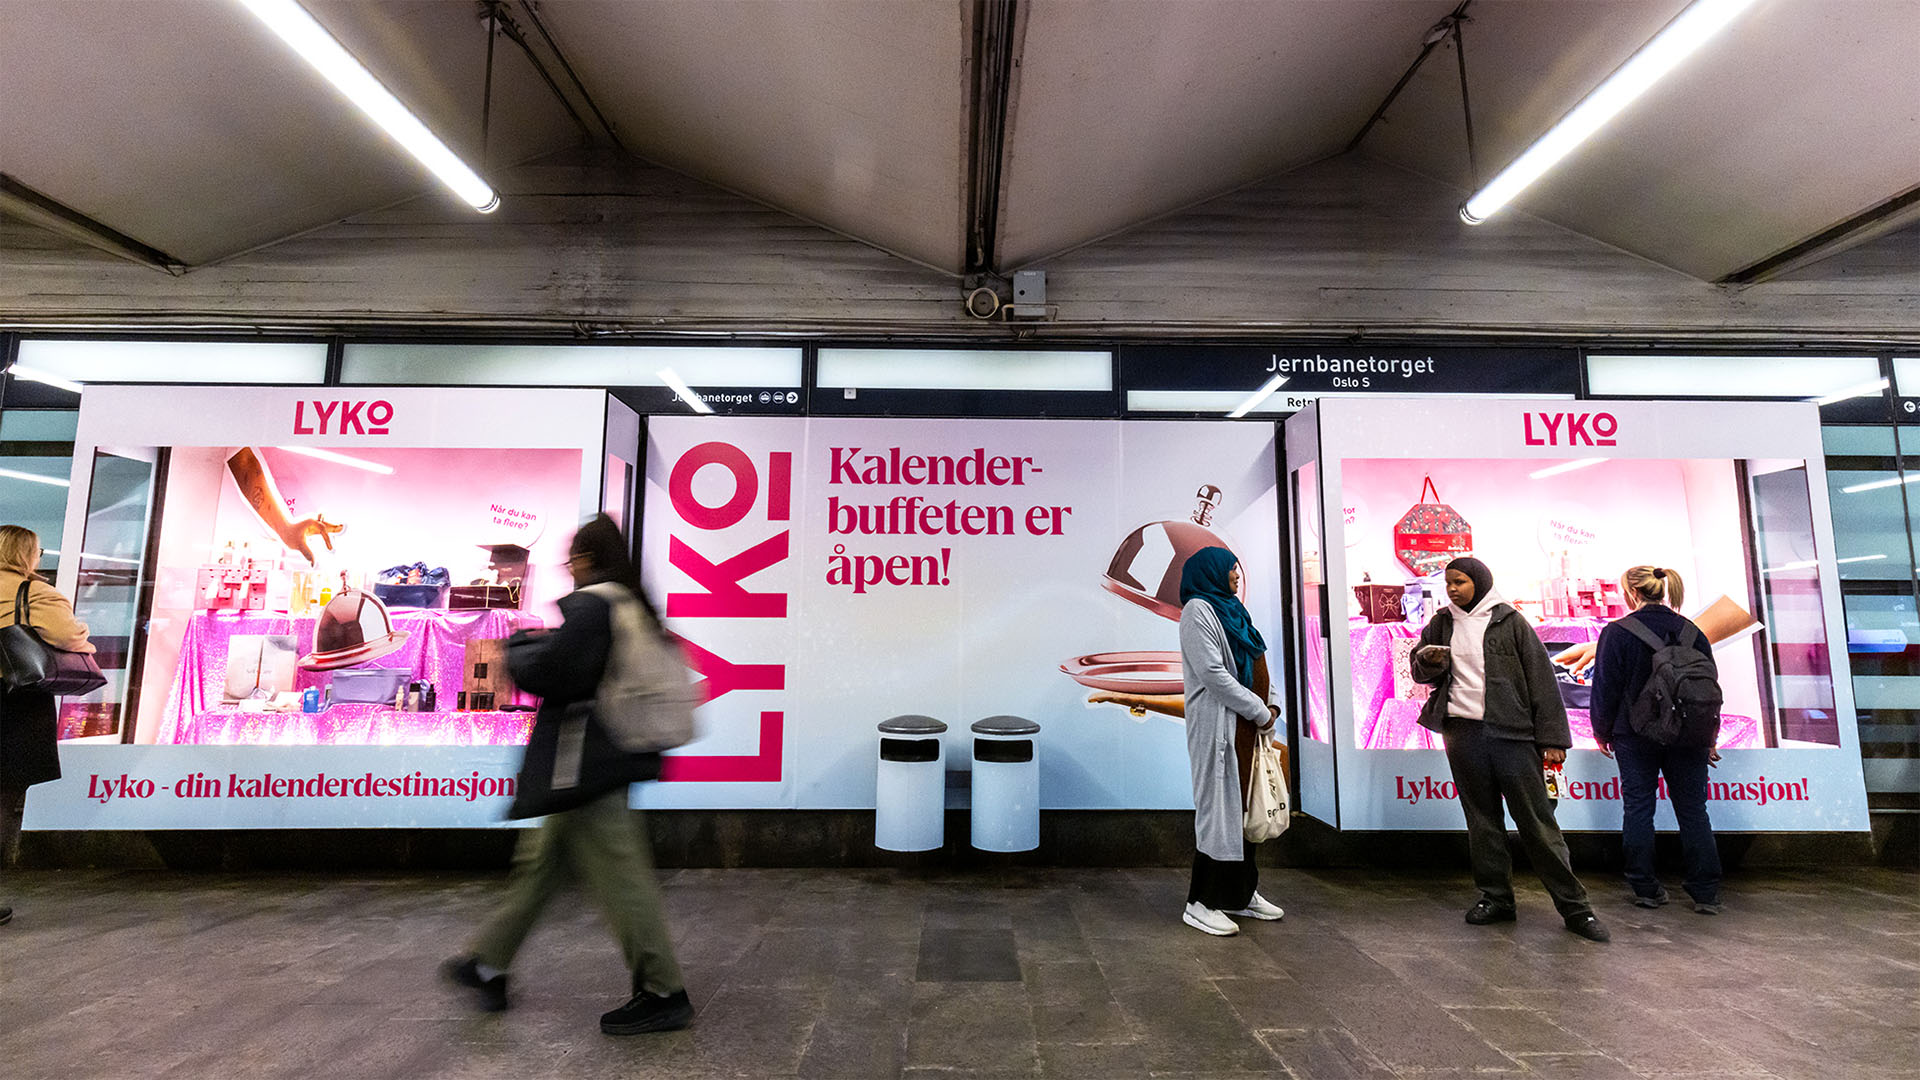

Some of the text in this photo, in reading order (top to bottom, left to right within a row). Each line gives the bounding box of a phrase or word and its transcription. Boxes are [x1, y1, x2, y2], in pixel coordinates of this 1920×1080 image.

[1266, 354, 1435, 378] Jernbanetorget
[1332, 377, 1370, 388] Oslo S
[294, 400, 394, 435] LYKO
[1523, 412, 1618, 446] LYKO
[829, 447, 1043, 486] Kalender-
[490, 503, 537, 521] Når du kan
[493, 516, 502, 525] ta
[828, 496, 1072, 536] buffeten er
[1567, 525, 1579, 535] du
[826, 543, 951, 594] åpen!
[658, 441, 792, 782] LYKO
[88, 774, 155, 804] Lyko
[175, 772, 221, 798] din
[227, 770, 518, 802] kalenderdestinasjon
[1395, 775, 1459, 805] Lyko
